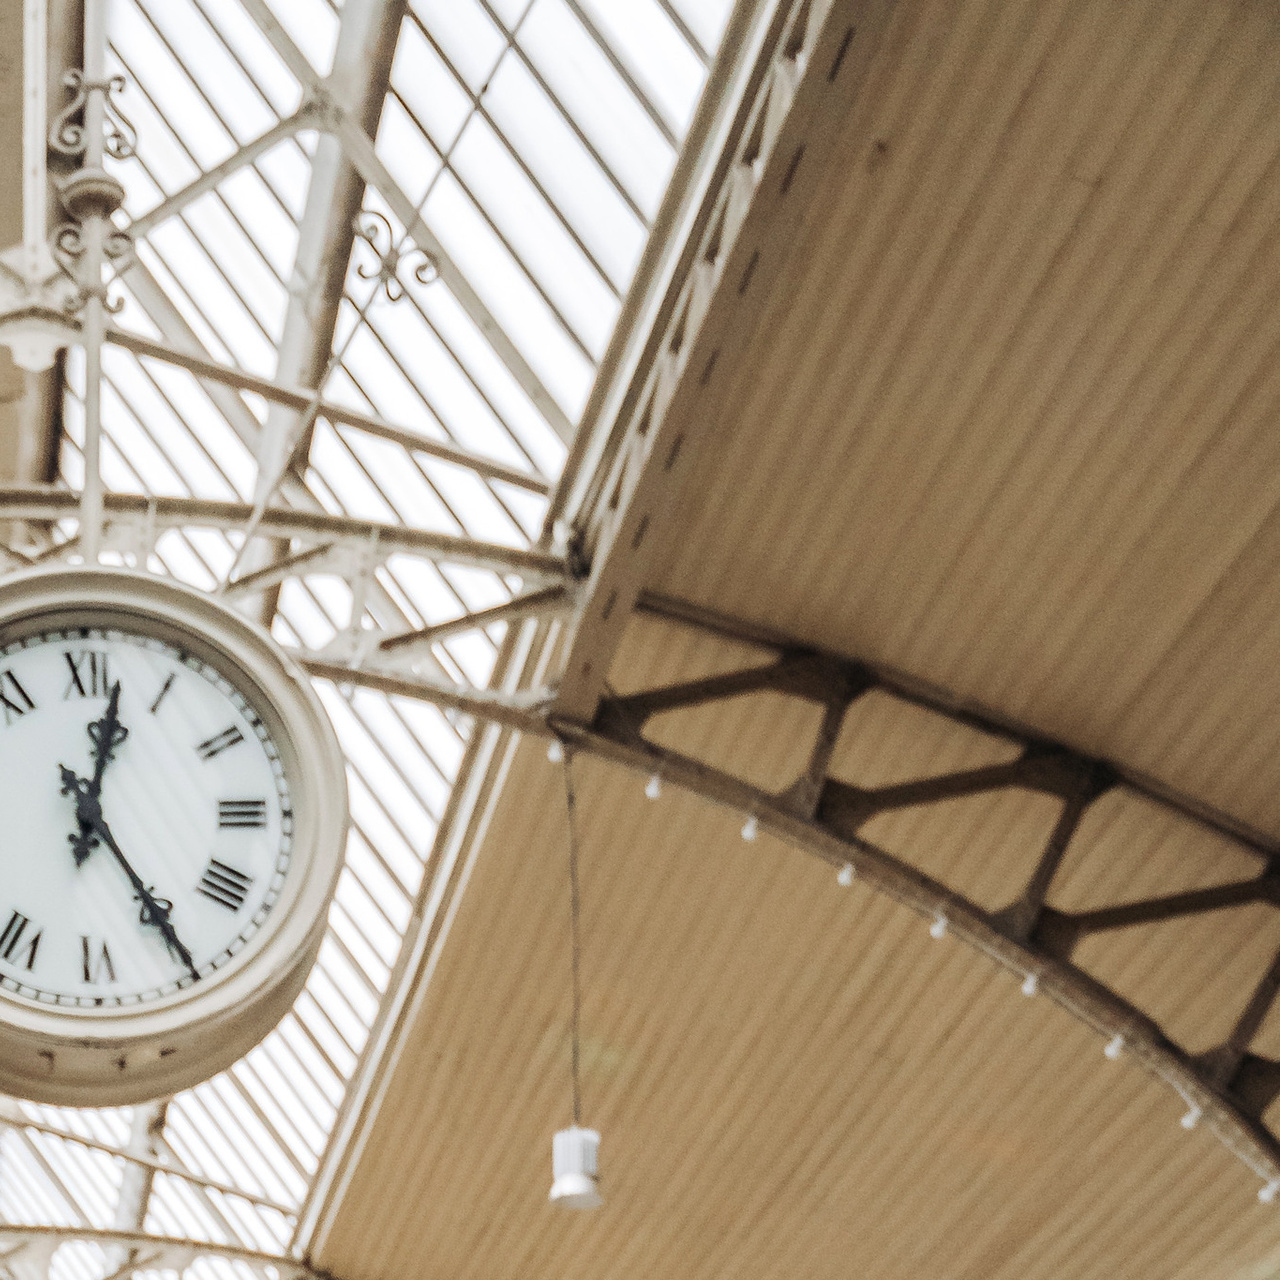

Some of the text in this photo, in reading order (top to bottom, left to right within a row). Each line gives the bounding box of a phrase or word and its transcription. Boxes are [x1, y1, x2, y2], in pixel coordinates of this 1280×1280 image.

[63, 650, 109, 699] XII
[150, 671, 177, 713] I
[197, 725, 244, 760] II
[219, 799, 267, 829] III
[195, 858, 253, 912] IIII
[80, 935, 117, 984] VI
